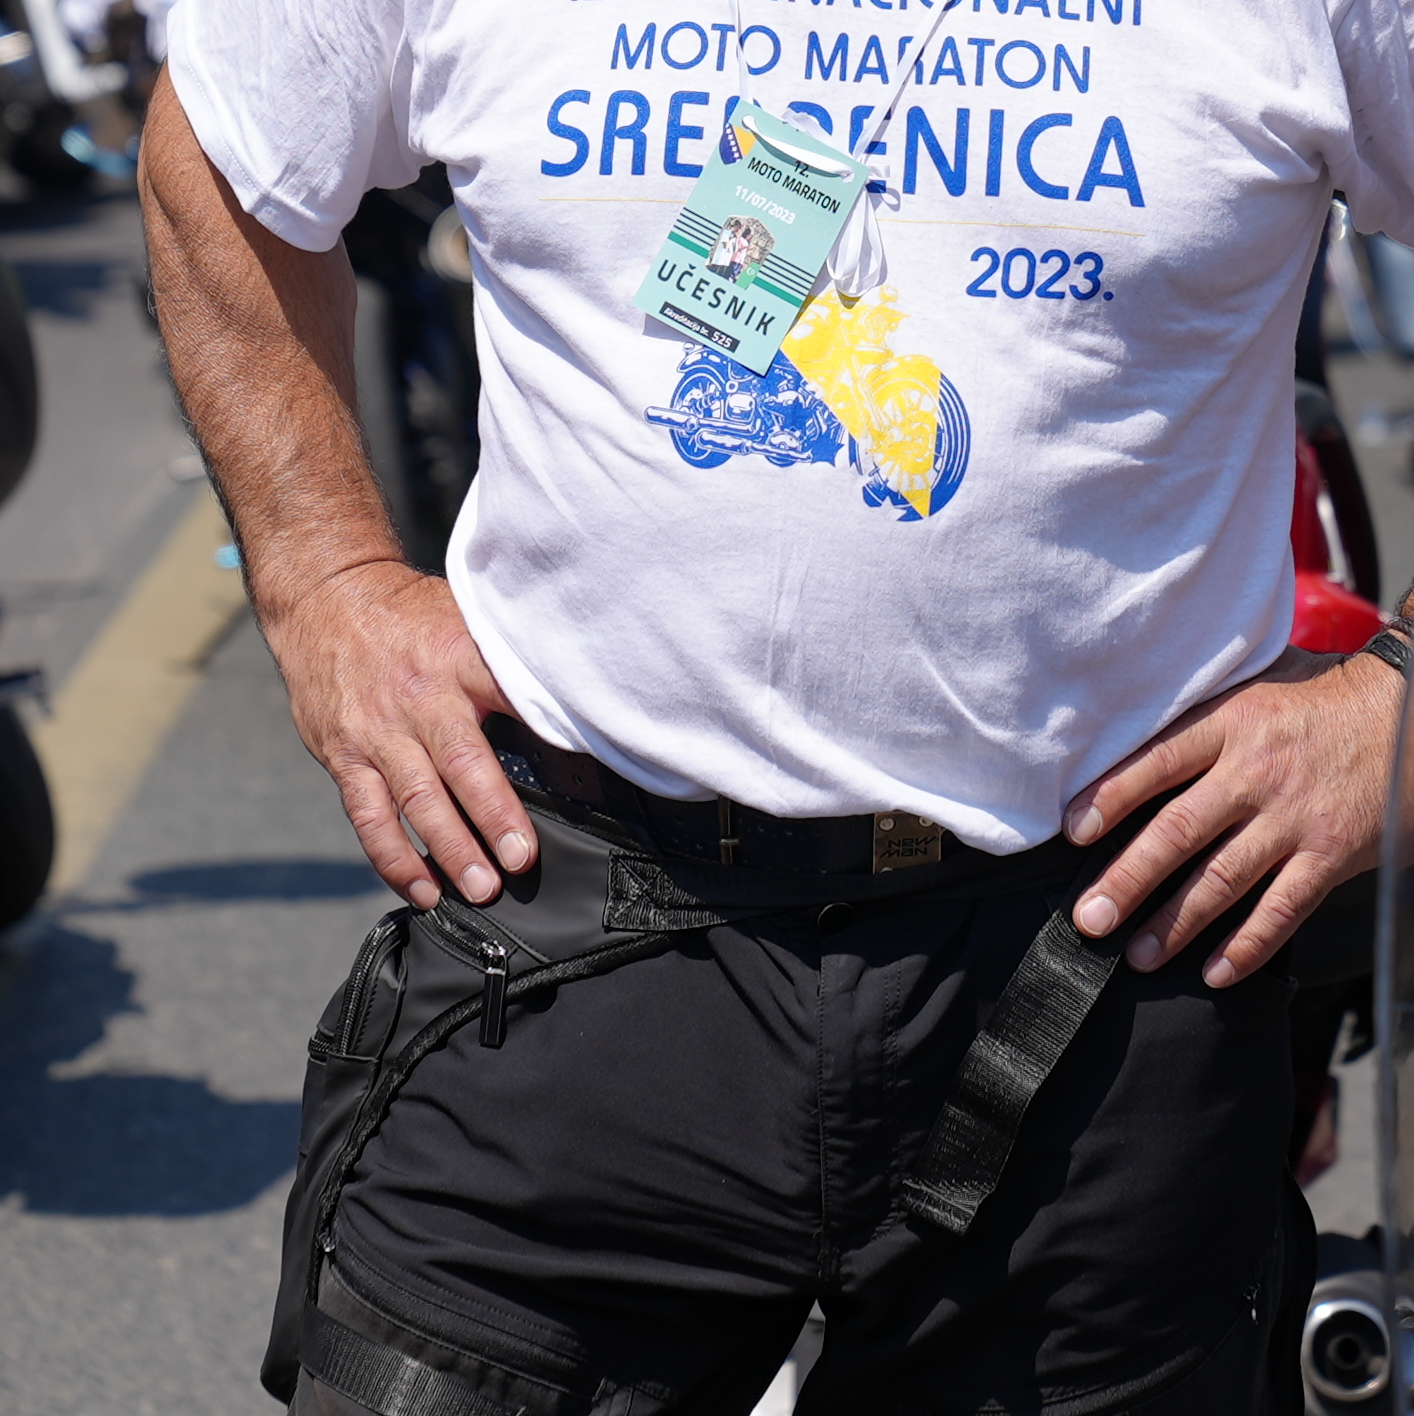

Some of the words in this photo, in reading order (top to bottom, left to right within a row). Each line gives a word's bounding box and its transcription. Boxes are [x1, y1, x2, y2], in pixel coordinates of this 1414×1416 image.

[610, 20, 782, 76] MOTO
[804, 30, 1091, 95] MARATON
[540, 88, 1146, 209] SREENICA
[794, 159, 810, 179] 12.
[734, 184, 796, 226] 11/07/2023
[747, 156, 783, 184] MOTO
[781, 174, 842, 215] MARATON
[656, 258, 777, 337] UČESNIK
[965, 245, 1115, 302] 2023.
[710, 330, 734, 349] 525
